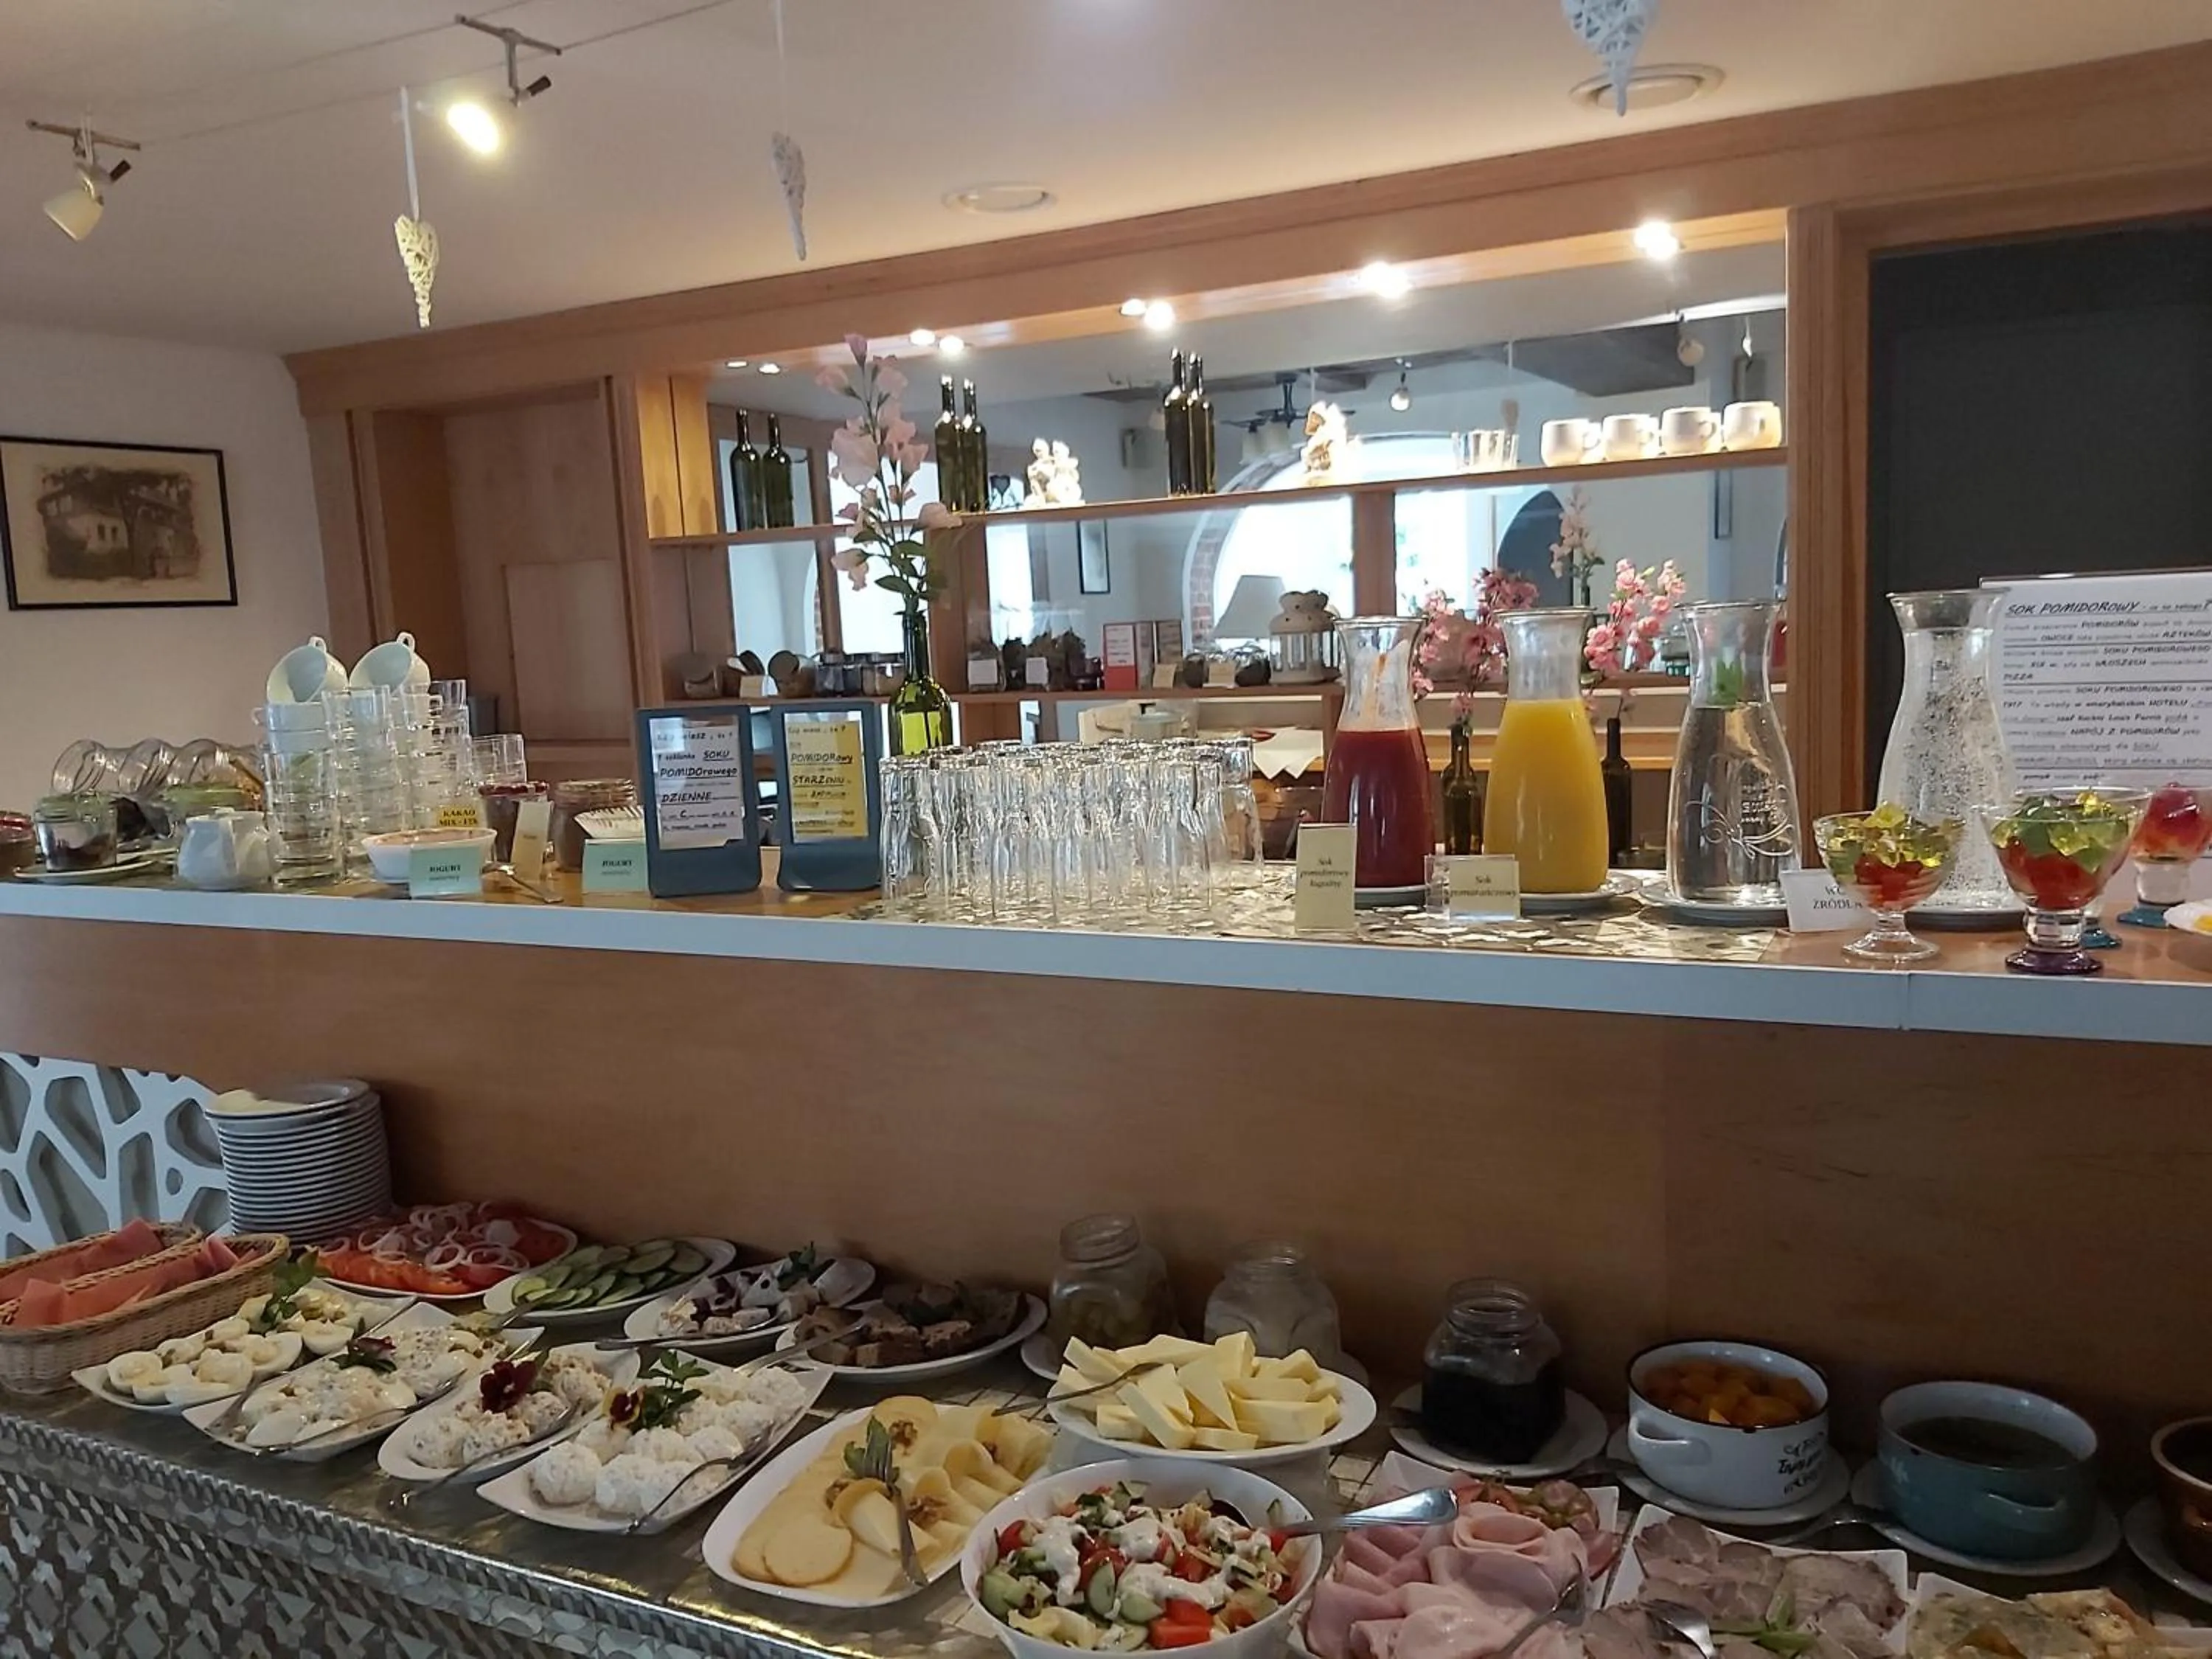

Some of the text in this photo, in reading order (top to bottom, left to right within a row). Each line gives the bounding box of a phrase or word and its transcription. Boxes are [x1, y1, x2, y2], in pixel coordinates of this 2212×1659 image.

[2008, 604, 2036, 614] SOK
[2039, 601, 2140, 614] POMIDOROWY
[703, 750, 731, 759] SOKU
[661, 791, 712, 804] DZIENNE
